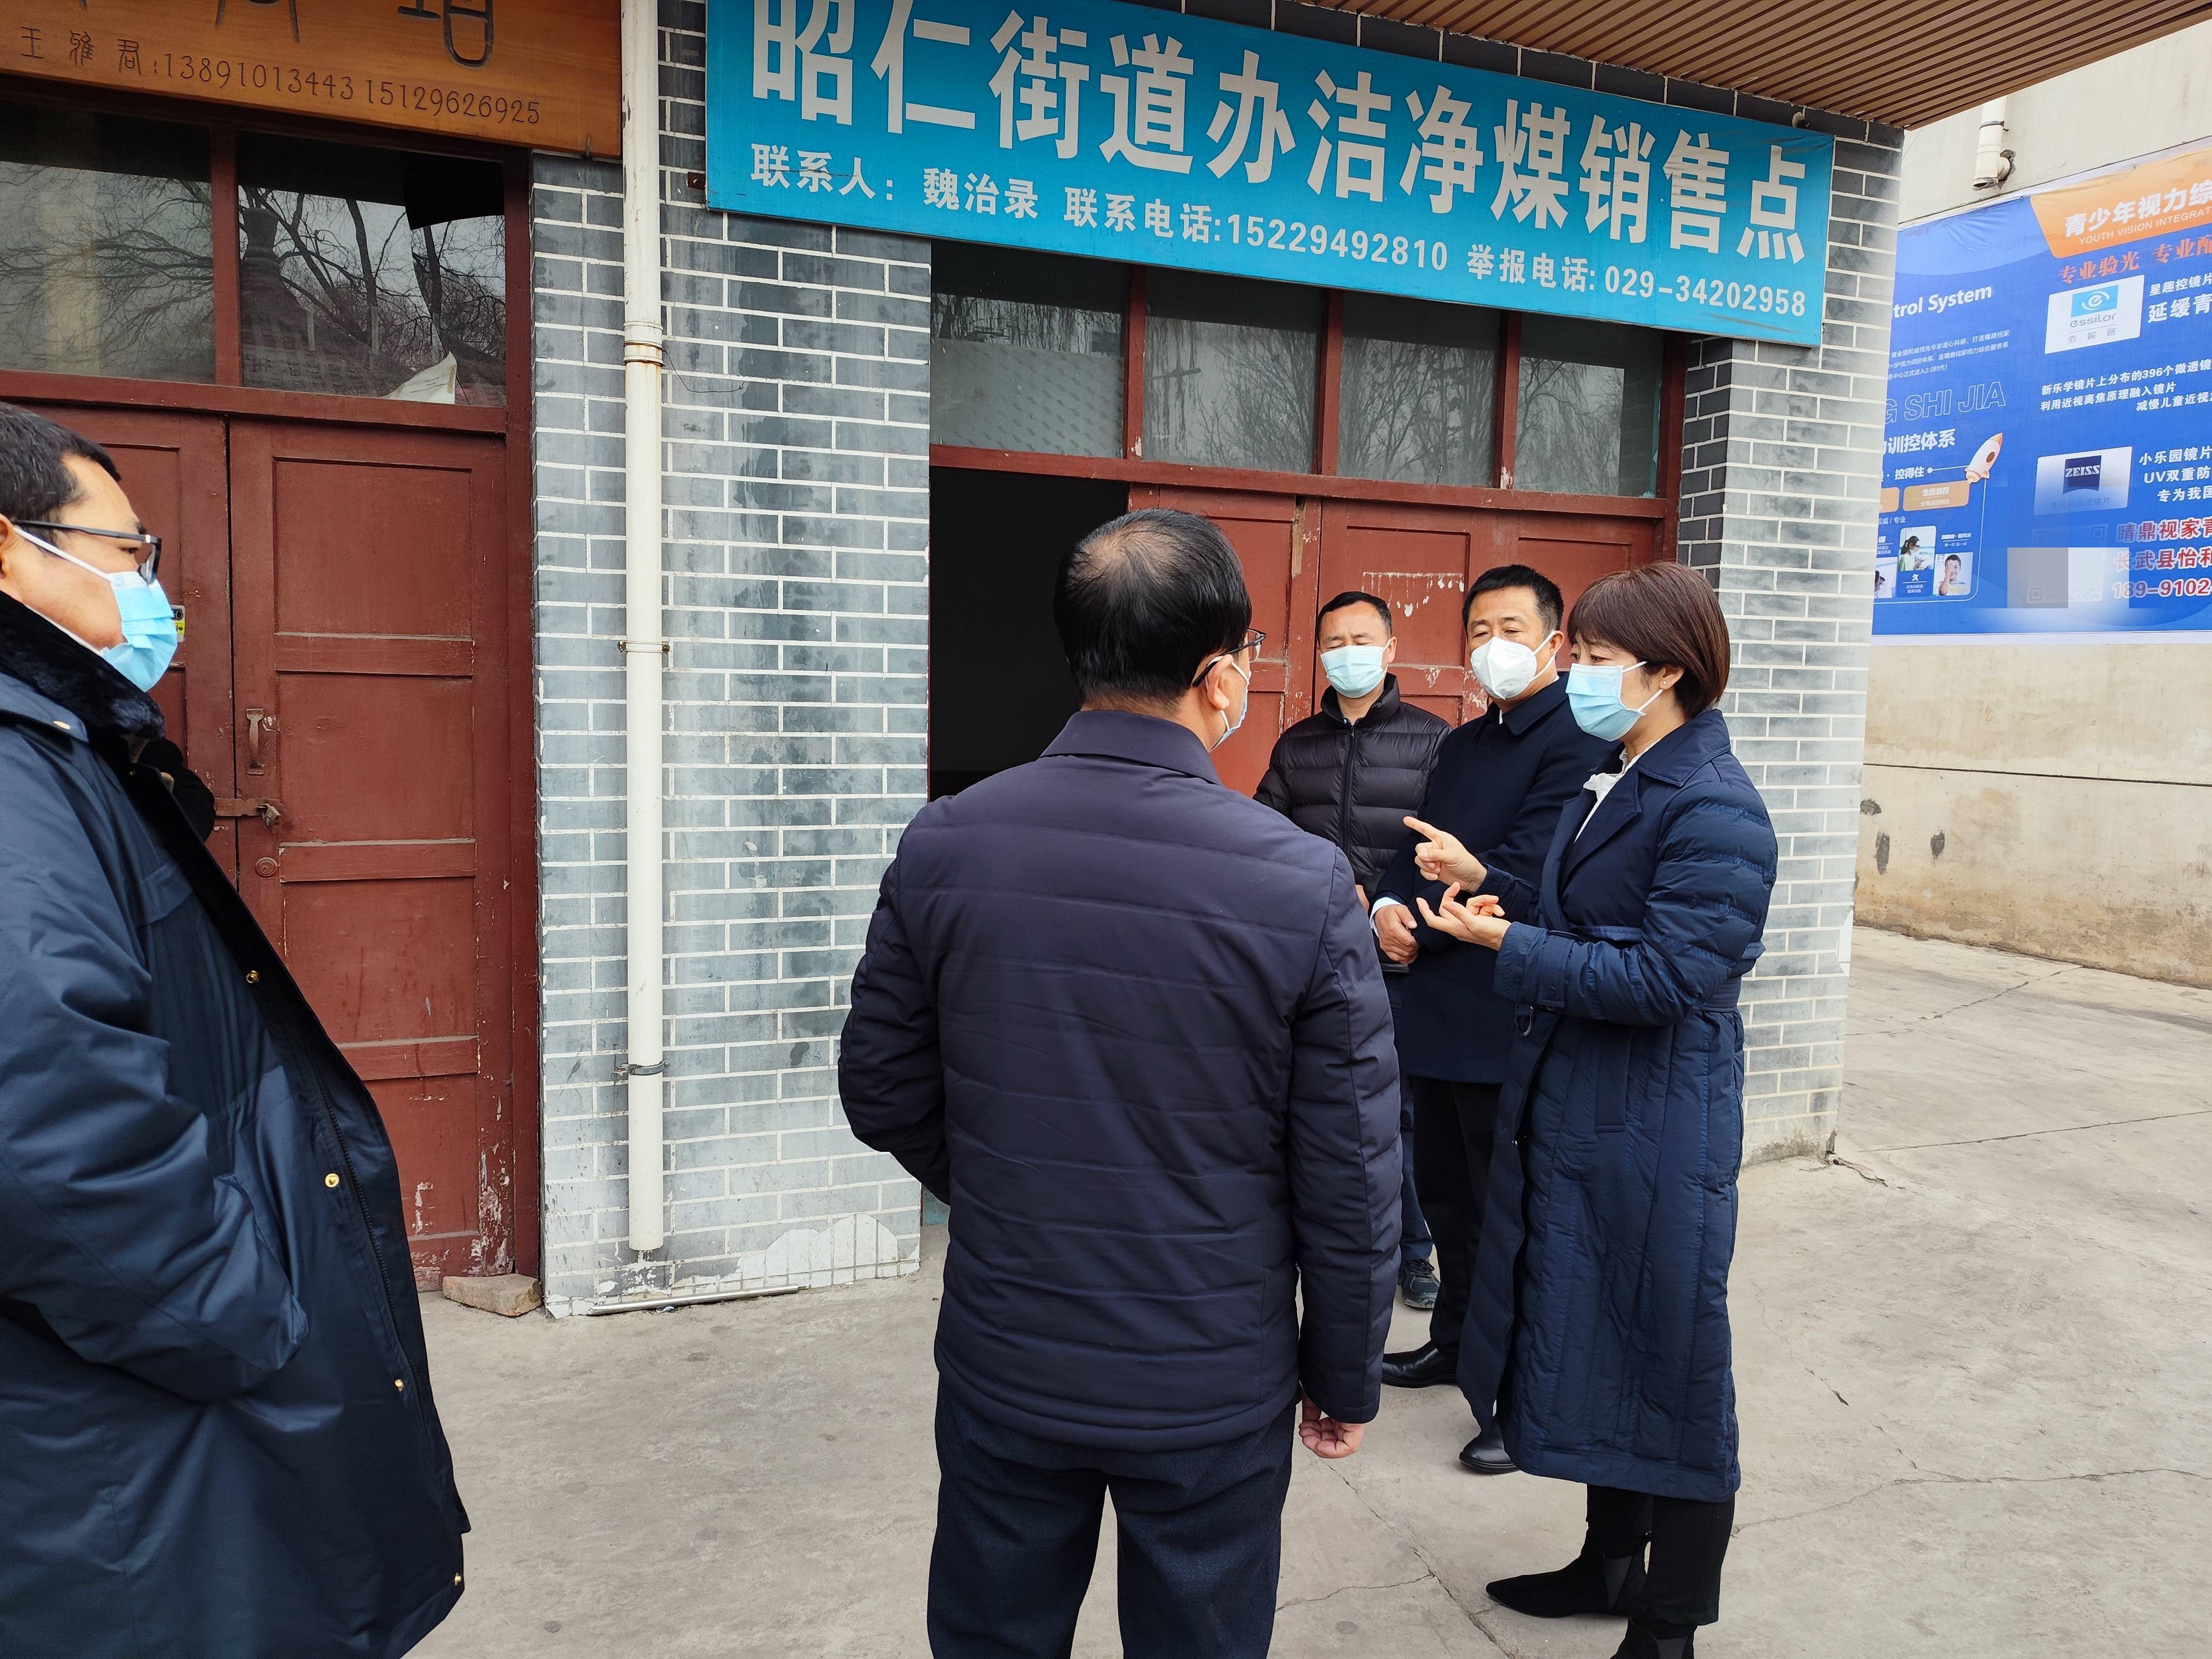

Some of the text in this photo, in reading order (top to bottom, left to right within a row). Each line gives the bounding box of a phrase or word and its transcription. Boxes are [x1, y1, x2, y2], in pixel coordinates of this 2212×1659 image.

[366, 79, 540, 125] 15129626925
[752, 0, 1806, 264] 昭仁街道办洁净煤销售点
[2079, 231, 2114, 246] YOUTH
[2117, 221, 2153, 236] VISION
[2058, 251, 2140, 285] 专业验光
[1928, 286, 1992, 314] System
[1904, 389, 1952, 421] SHI
[1958, 381, 2006, 413] JIA
[2040, 381, 2177, 412] 利用近视离焦原理融入镜片
[2136, 390, 2212, 412] 减慢儿童近视
[2065, 465, 2101, 478] ZEISS
[2112, 578, 2212, 599] 189-9102
